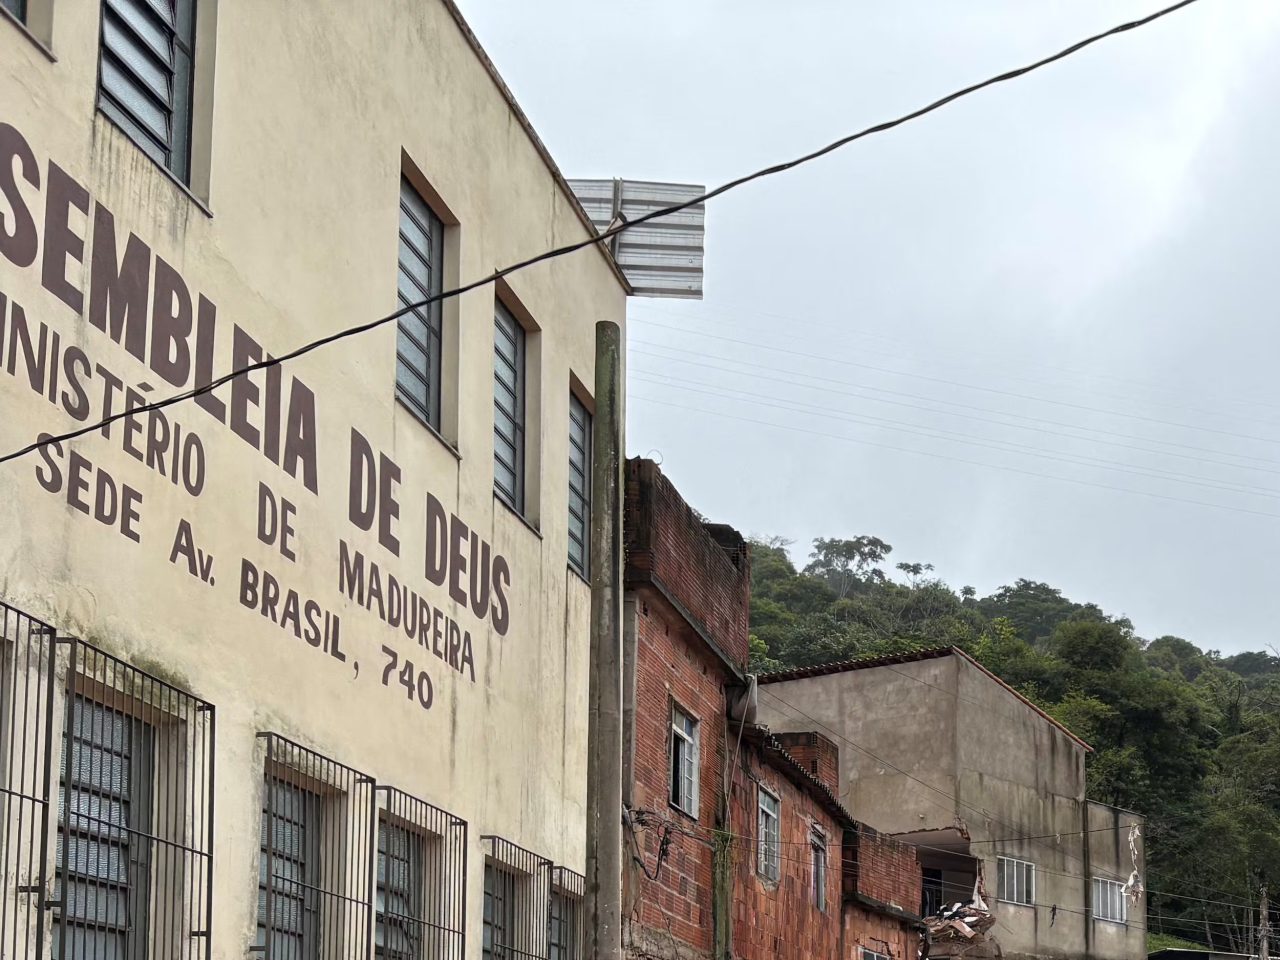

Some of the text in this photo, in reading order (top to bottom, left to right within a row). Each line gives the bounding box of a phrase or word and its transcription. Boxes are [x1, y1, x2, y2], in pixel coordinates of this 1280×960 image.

[0, 122, 511, 637] SEMBLEIA DE DEUS
[35, 432, 143, 544] SEDE
[381, 643, 434, 711] 740
[257, 481, 297, 563] DE
[338, 539, 476, 684] MADUREIRA
